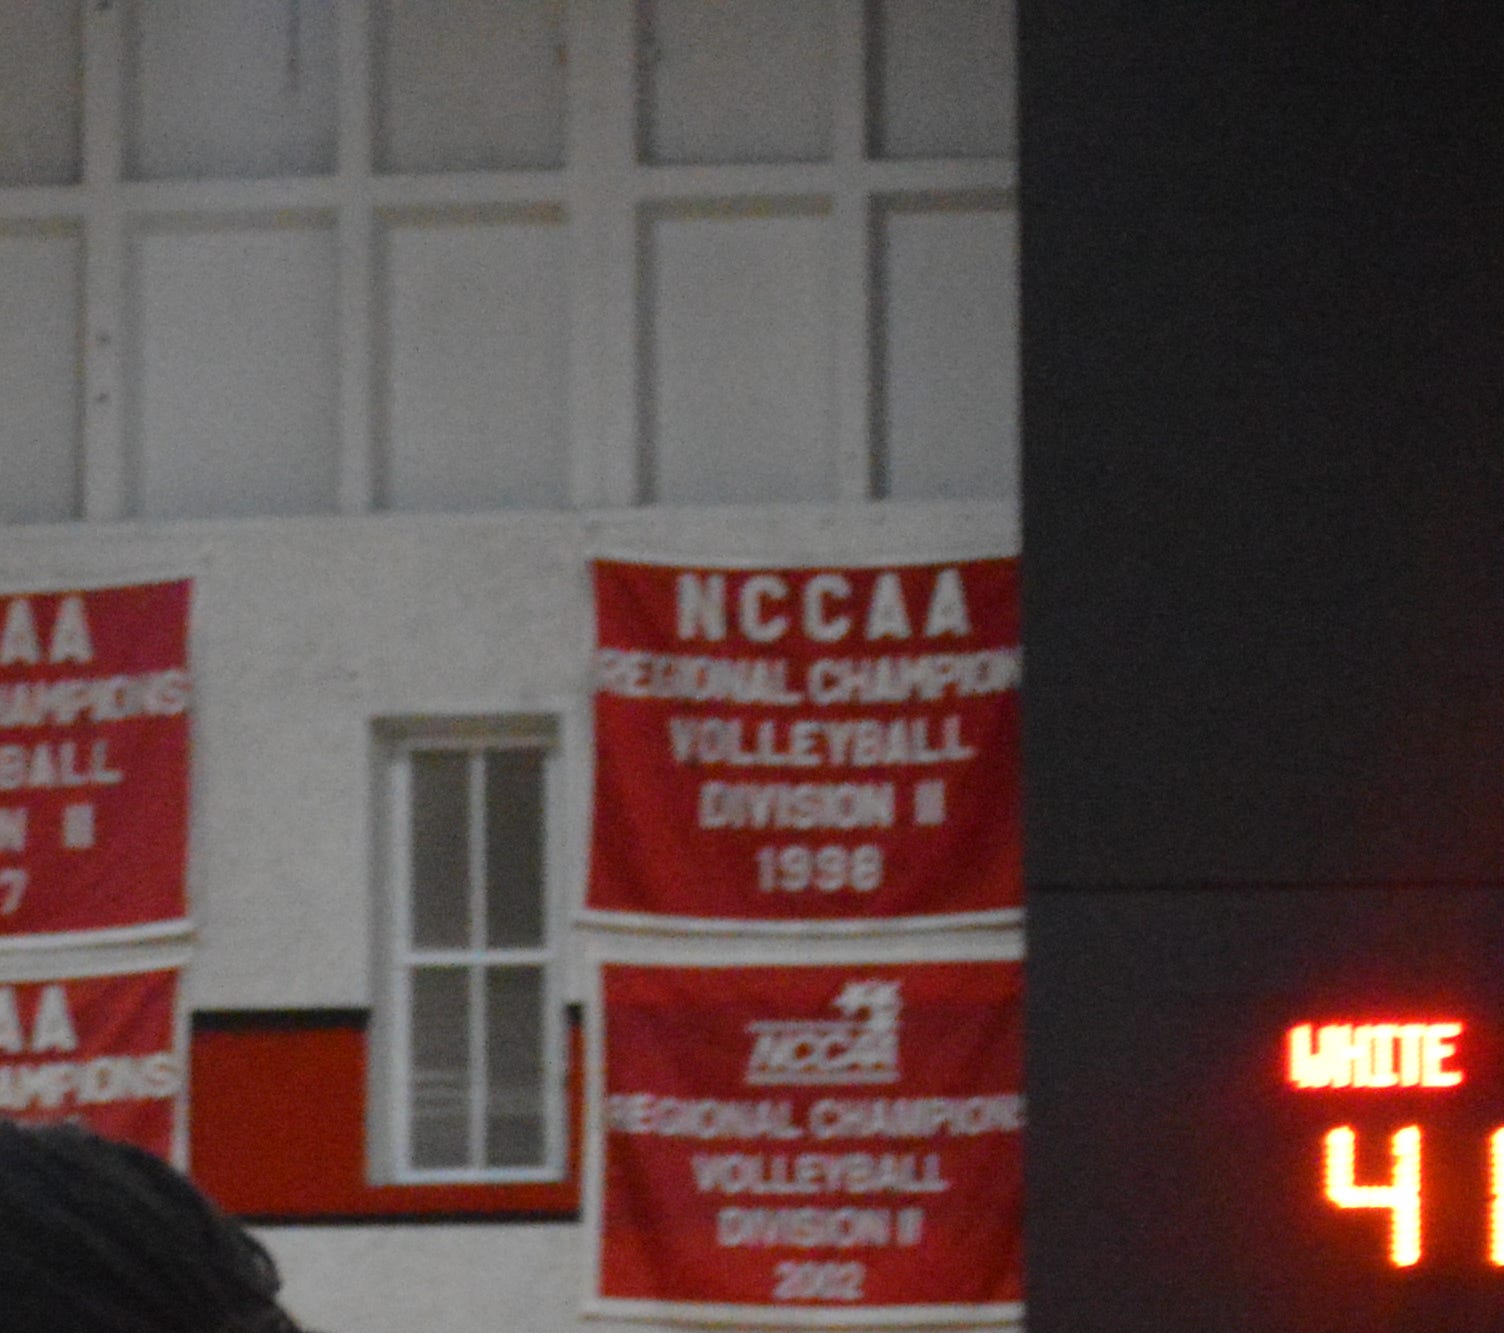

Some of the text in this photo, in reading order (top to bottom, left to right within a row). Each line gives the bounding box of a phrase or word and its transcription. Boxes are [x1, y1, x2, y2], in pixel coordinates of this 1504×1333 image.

[675, 567, 972, 644] NCCAA
[594, 647, 801, 705] REGIONAL
[669, 714, 978, 768] VOLLEYBALL
[698, 780, 895, 831] DIVISION
[755, 843, 885, 895] 1998
[1288, 1022, 1464, 1088] WHITE
[603, 1093, 803, 1139] REGIONAL
[691, 1152, 950, 1194] VOLLEYBALL
[715, 1206, 887, 1249] DIVISION
